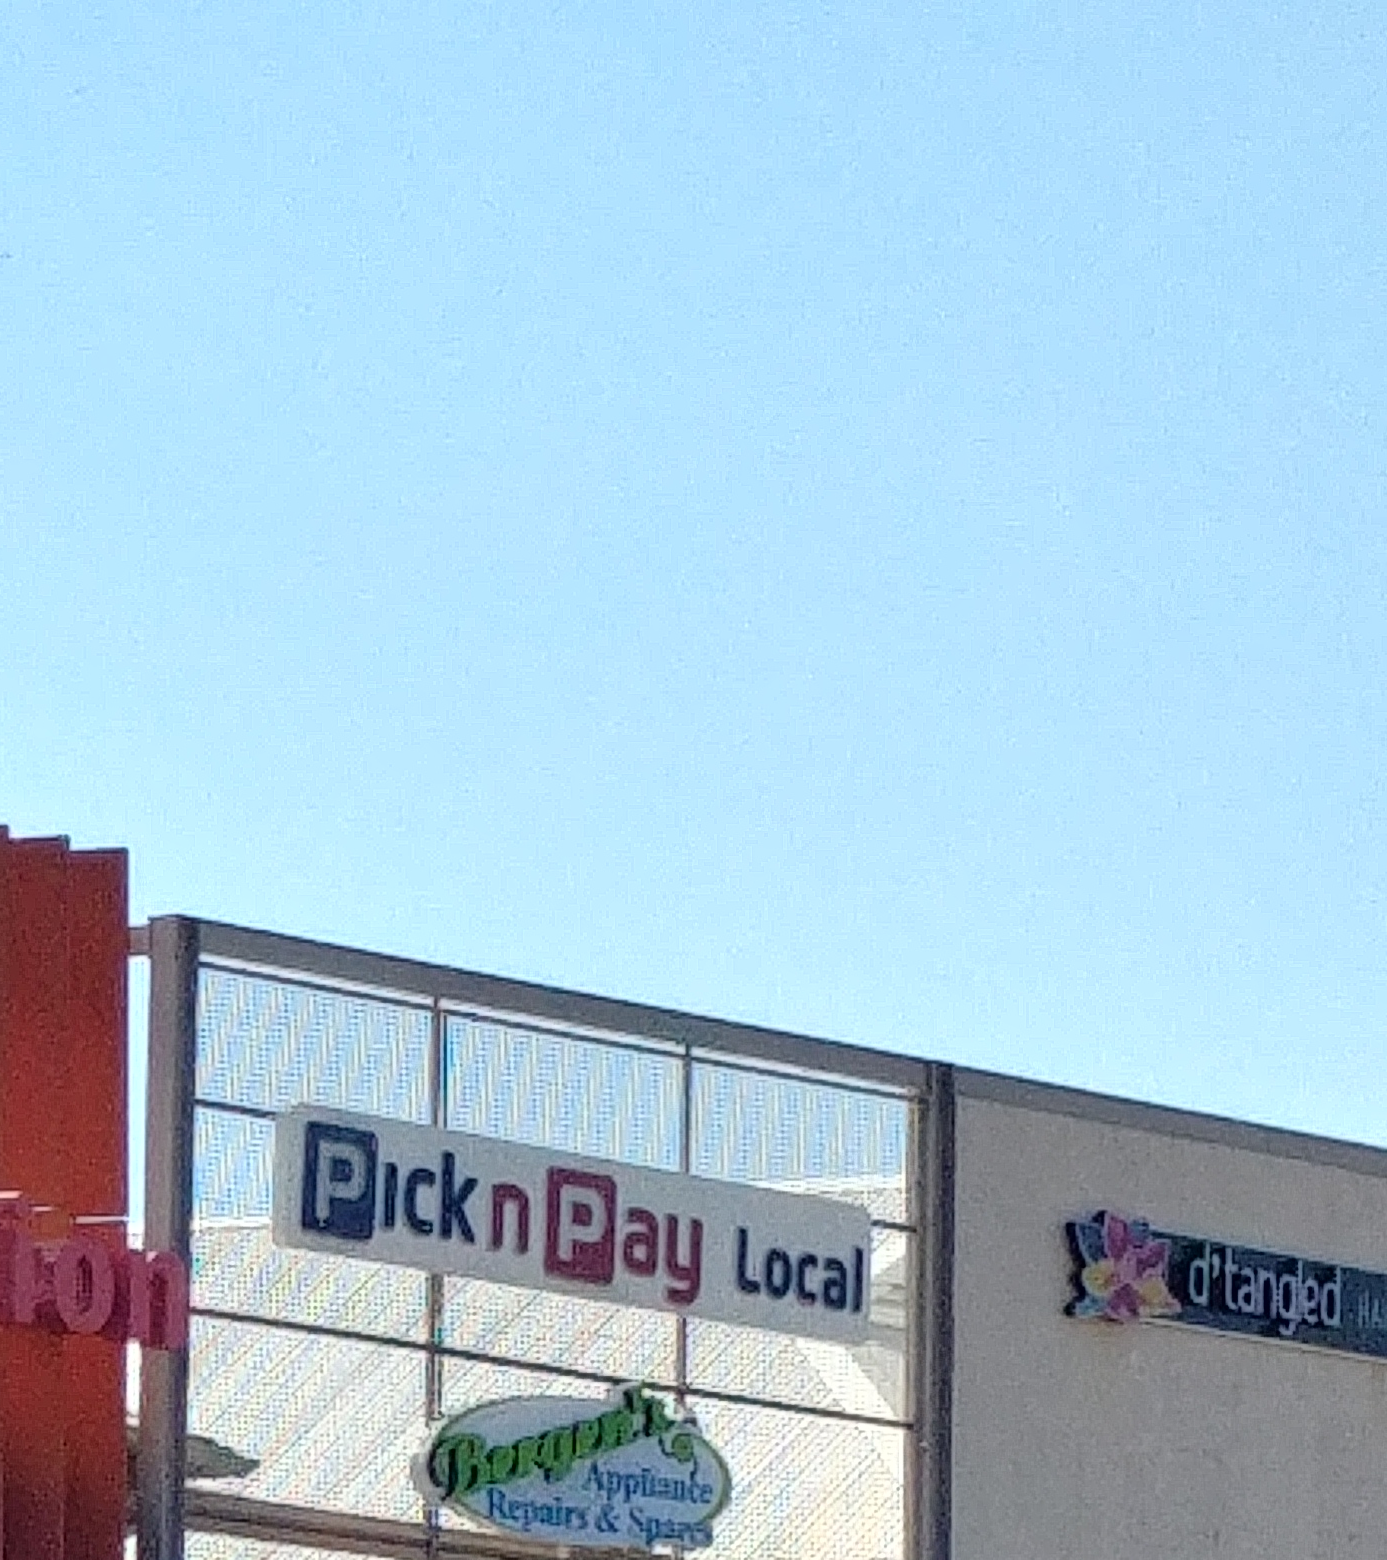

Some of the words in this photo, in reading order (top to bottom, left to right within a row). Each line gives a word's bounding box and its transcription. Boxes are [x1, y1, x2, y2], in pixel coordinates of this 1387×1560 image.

[301, 1120, 479, 1246] Pick
[487, 1182, 529, 1256] n
[543, 1165, 704, 1305] Pay
[735, 1226, 864, 1314] Local
[1189, 1242, 1341, 1335] d'tangled
[487, 1487, 589, 1532] Repairs
[593, 1504, 620, 1533] &
[585, 1462, 714, 1504] Appliance
